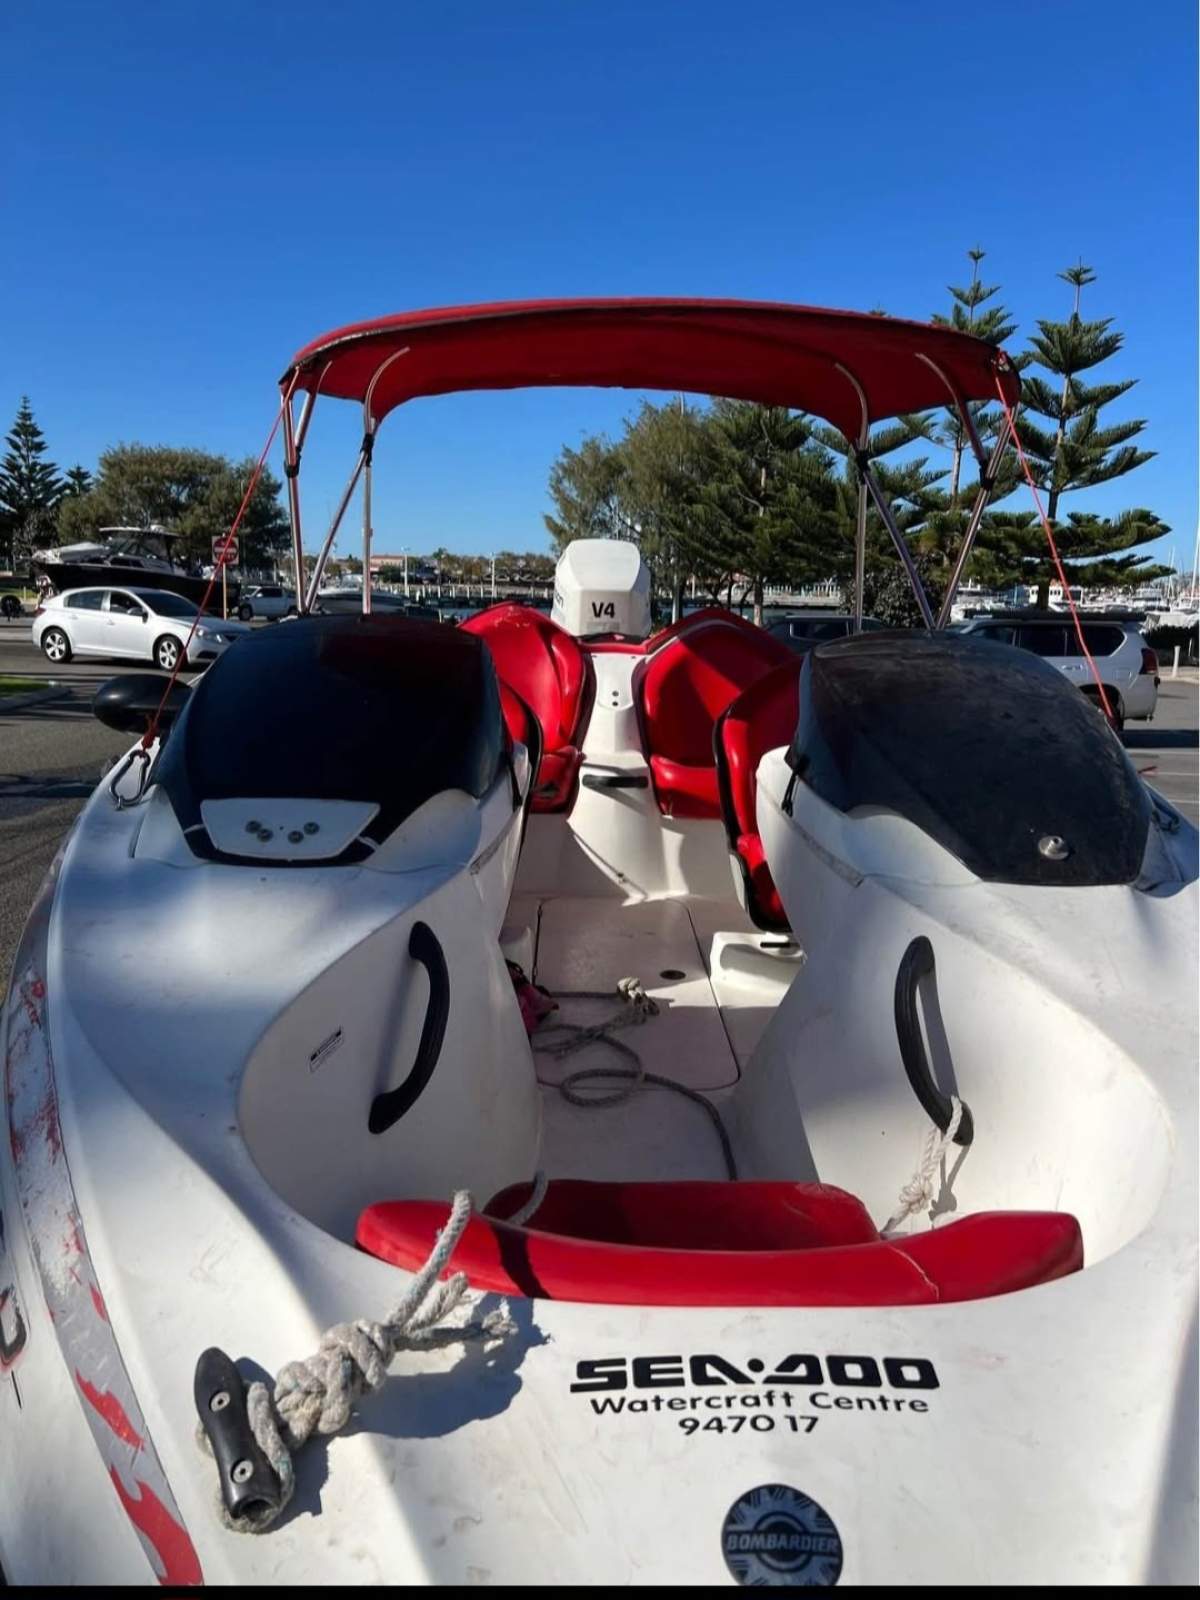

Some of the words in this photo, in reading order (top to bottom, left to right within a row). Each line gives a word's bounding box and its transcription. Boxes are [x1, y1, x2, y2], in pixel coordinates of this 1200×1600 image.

[592, 602, 615, 618] V4
[590, 1390, 794, 1415] Watercraft
[809, 1391, 929, 1412] Centre
[678, 1414, 775, 1436] 9470
[784, 1414, 819, 1434] 17
[726, 1533, 840, 1553] BOMBARDIER
